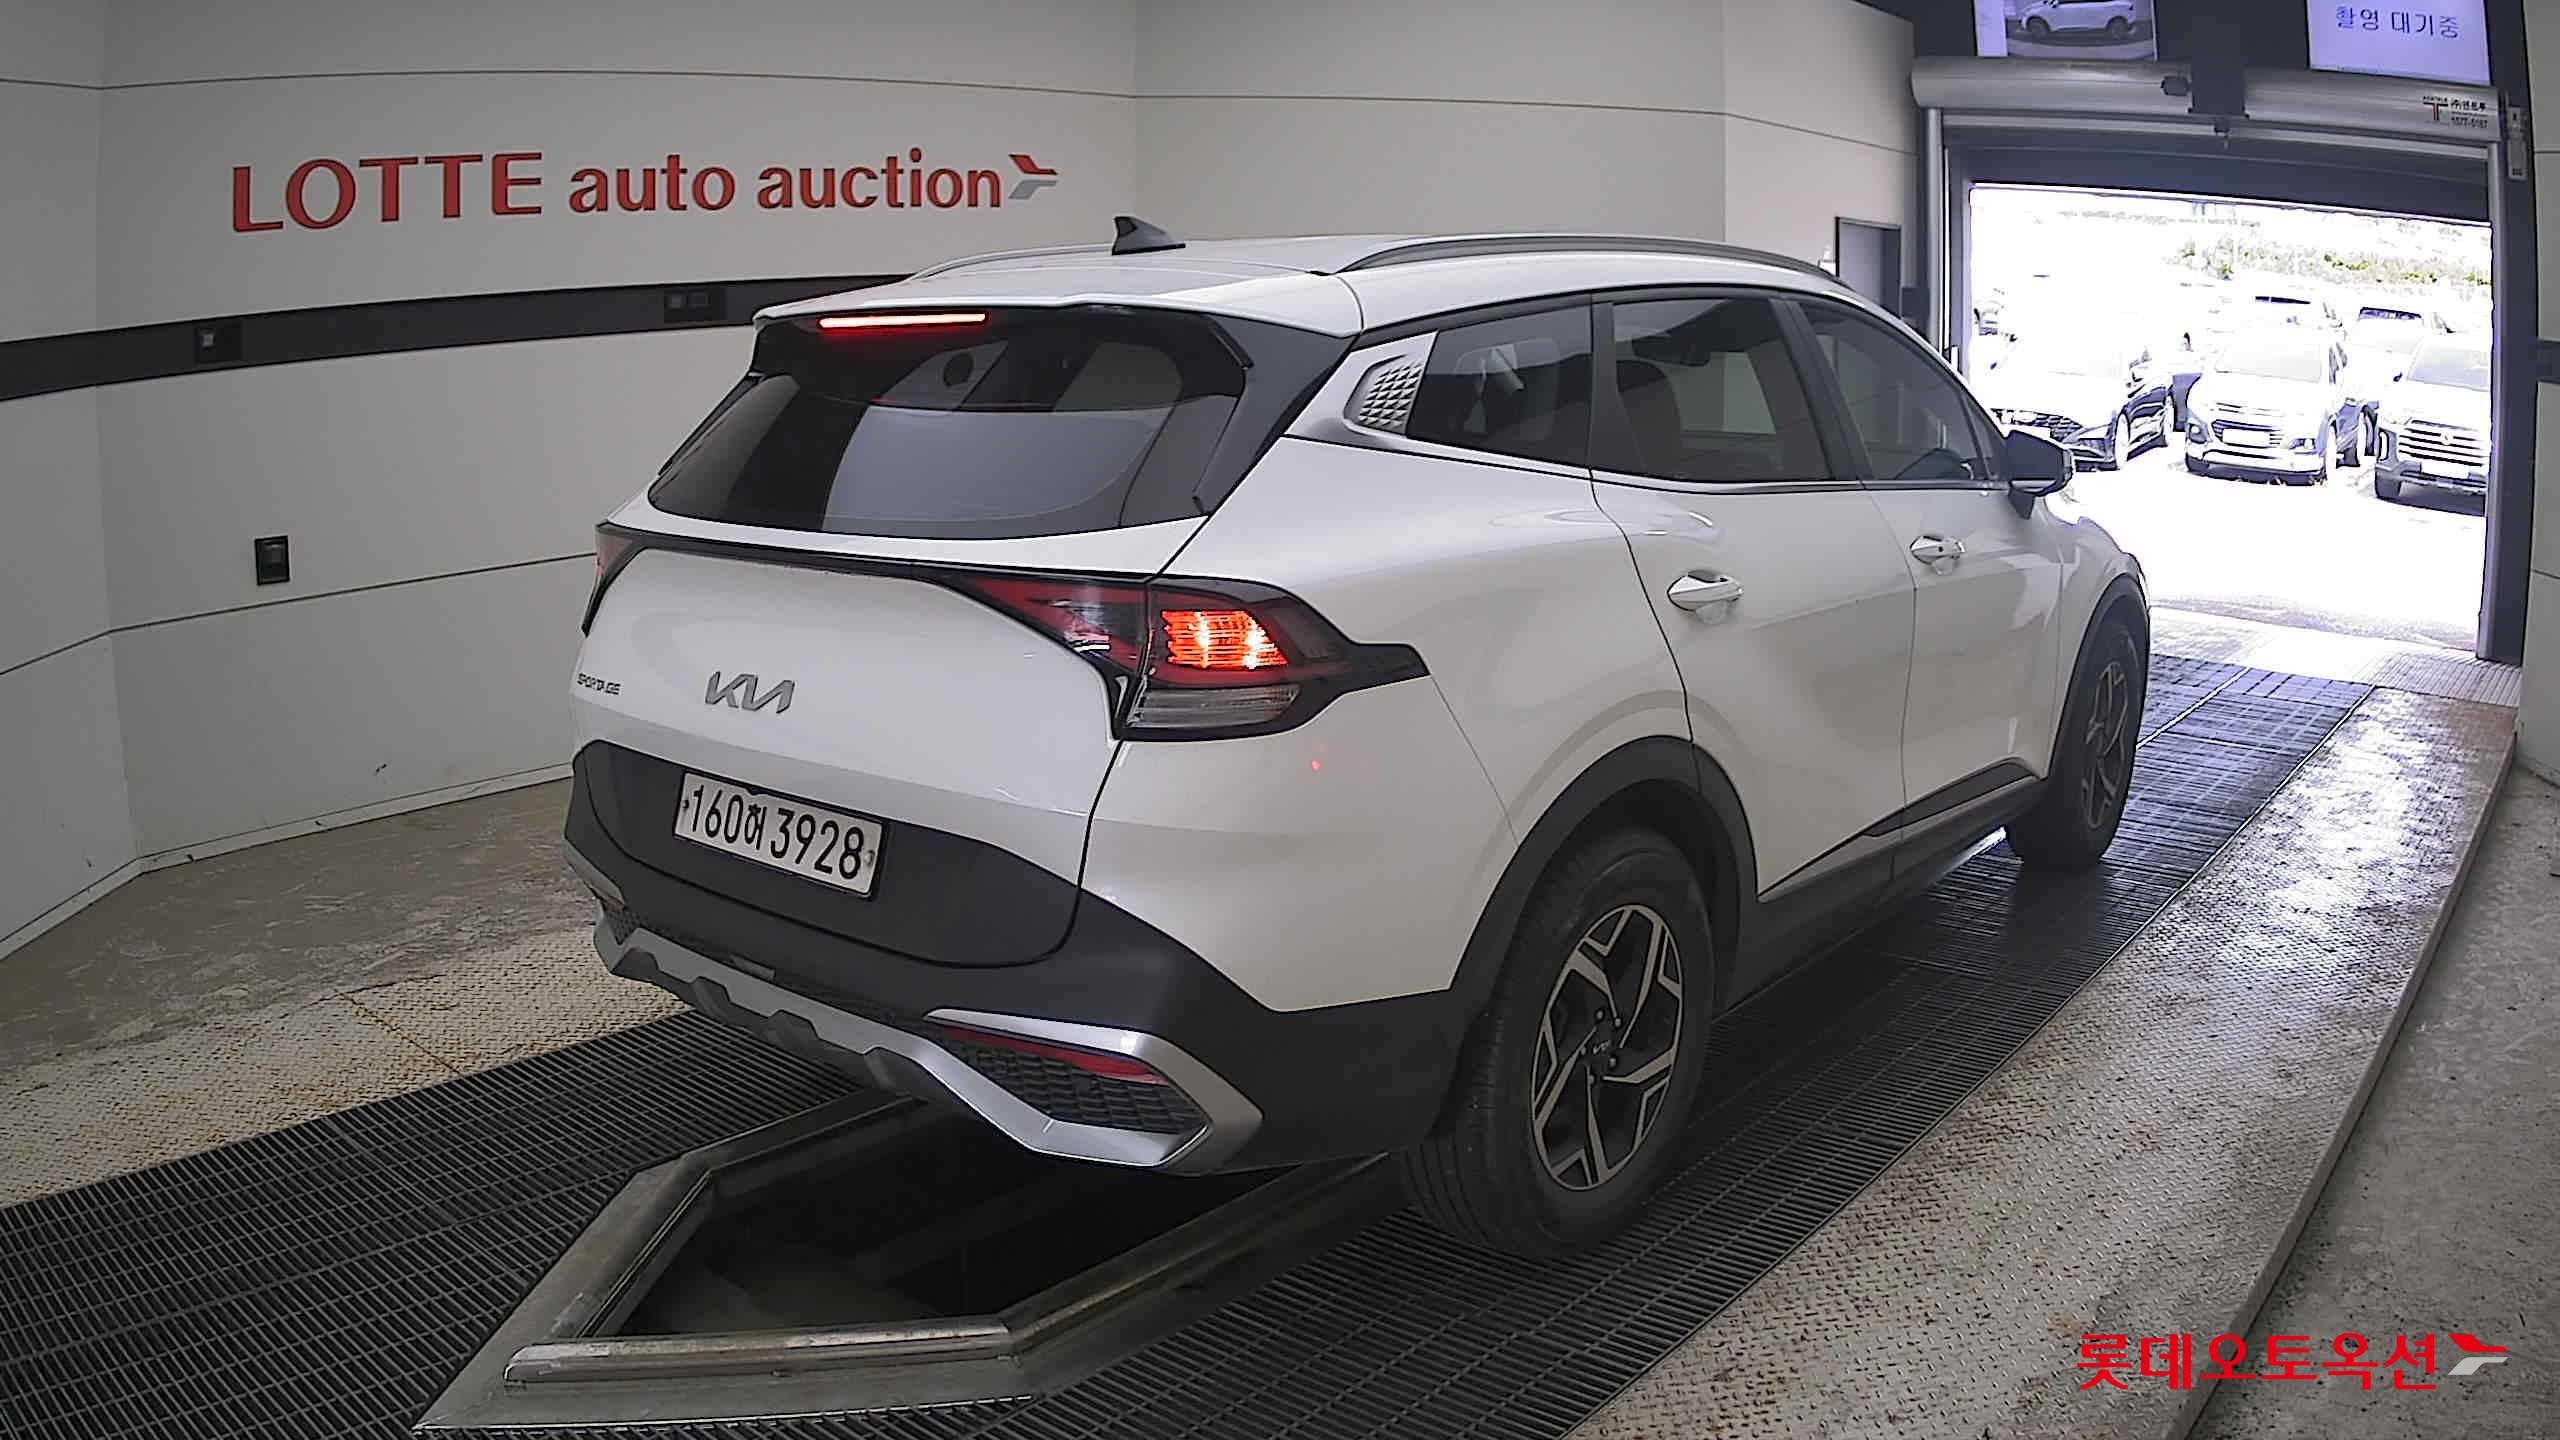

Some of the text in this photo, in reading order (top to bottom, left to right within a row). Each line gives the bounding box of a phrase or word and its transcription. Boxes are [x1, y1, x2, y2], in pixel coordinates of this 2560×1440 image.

[2336, 6, 2460, 39] 촬영 대기중
[233, 147, 1001, 233] LOTTE auto auction
[770, 808, 864, 880] 3928
